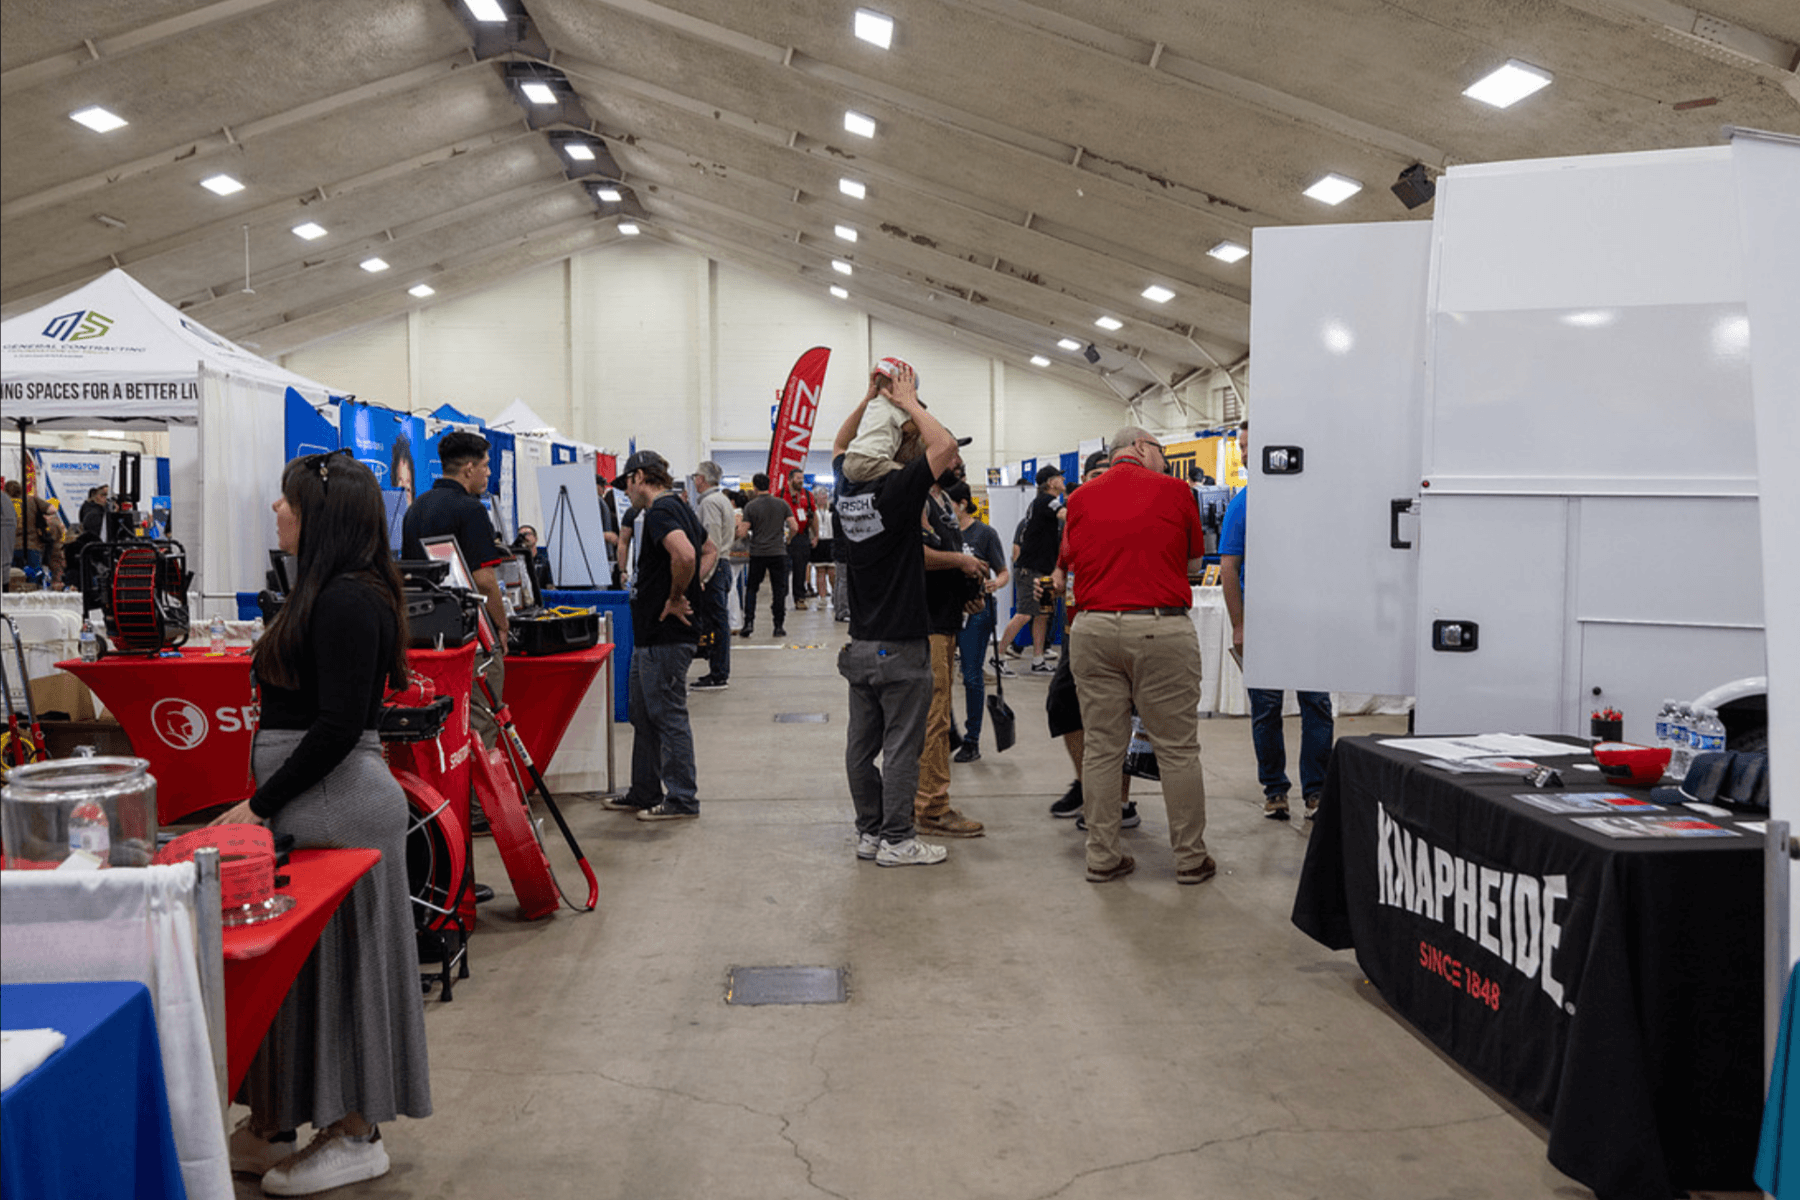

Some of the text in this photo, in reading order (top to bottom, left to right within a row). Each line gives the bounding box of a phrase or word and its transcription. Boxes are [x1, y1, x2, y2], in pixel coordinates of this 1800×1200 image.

[60, 343, 147, 353] CONTRACTING
[26, 382, 80, 400] SPACES
[82, 382, 110, 400] FOR
[112, 382, 122, 400] A
[125, 382, 178, 400] BETTER
[51, 462, 100, 470] HARRINGTON
[1377, 800, 1568, 1009] KNAPHEIDE
[1419, 941, 1501, 1012] SINCE 1848
